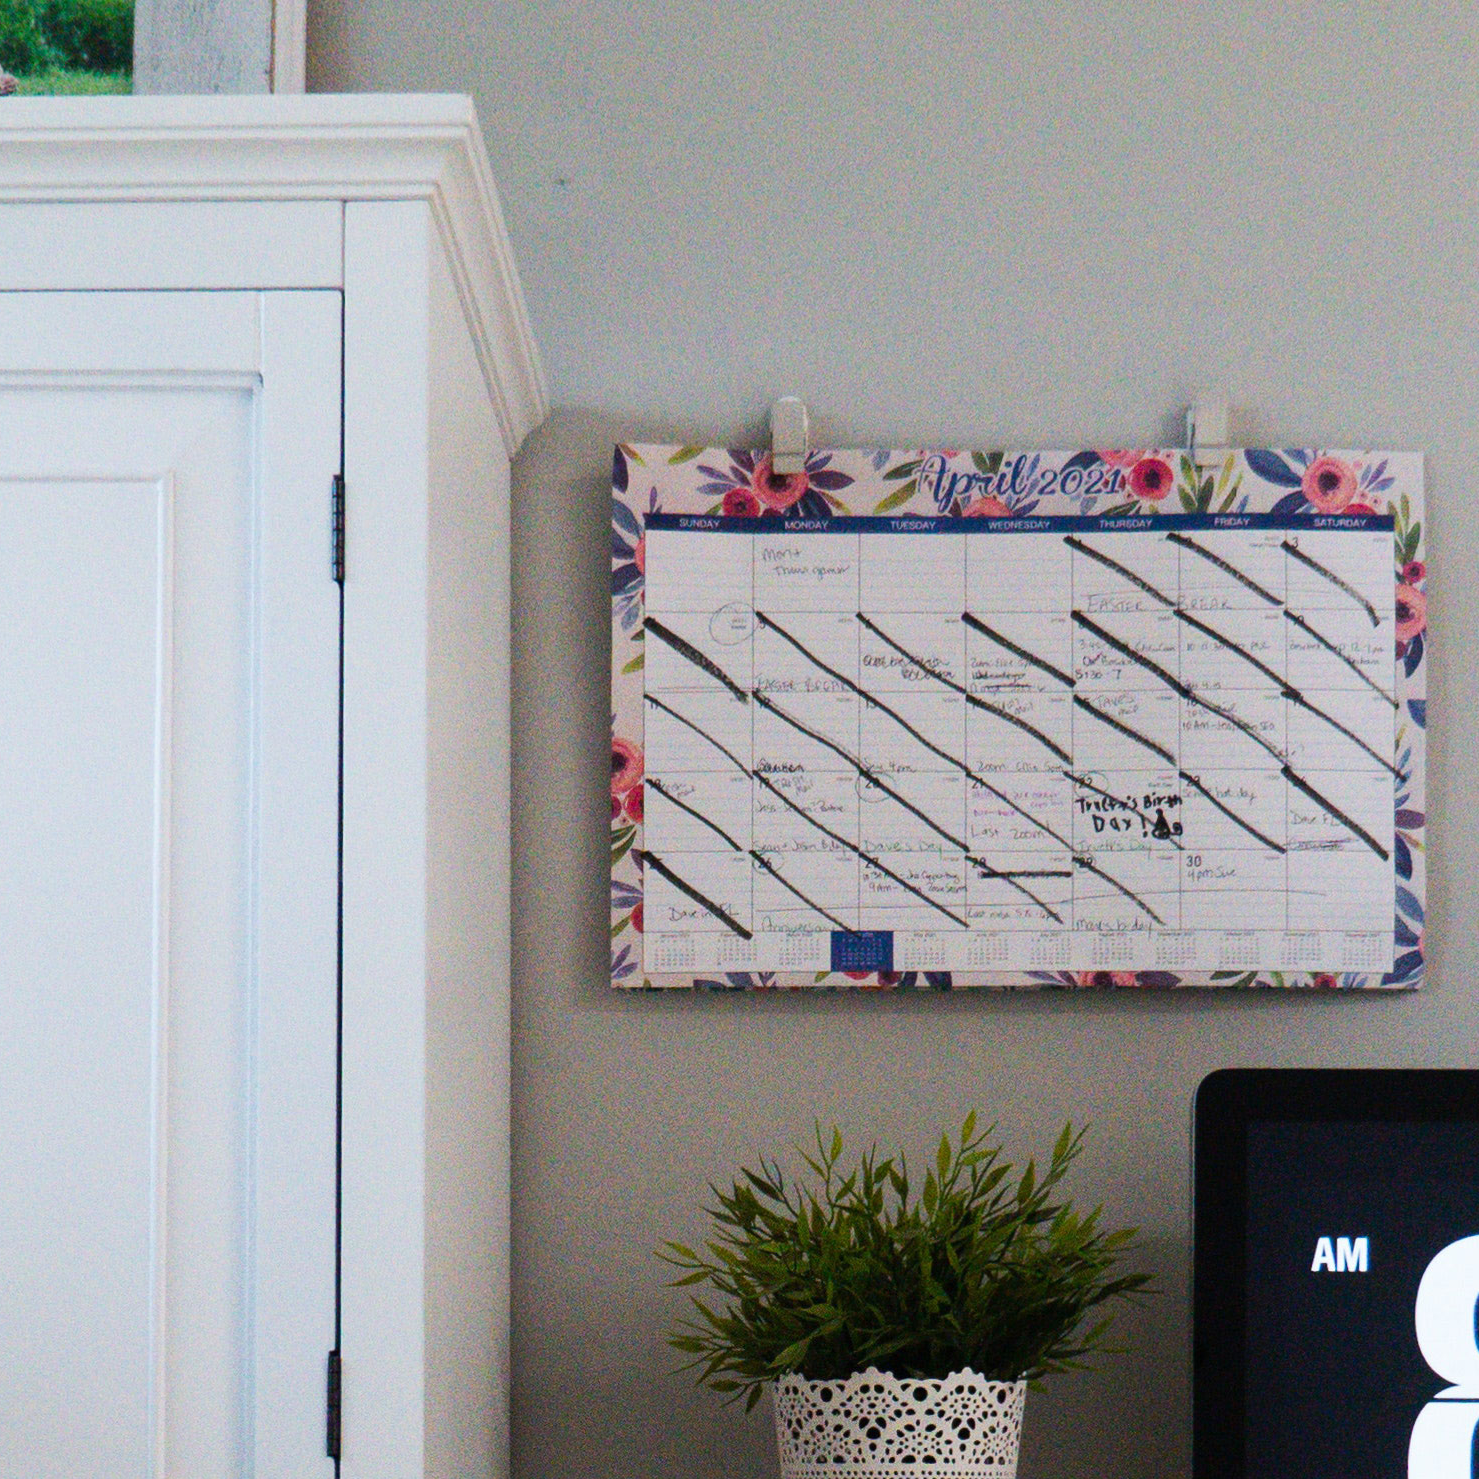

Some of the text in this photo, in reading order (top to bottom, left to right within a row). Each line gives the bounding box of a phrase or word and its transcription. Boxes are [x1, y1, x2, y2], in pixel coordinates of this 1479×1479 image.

[914, 453, 1123, 514] April 2021
[678, 517, 1368, 531] SUNDAY MONDAY TUESDAY WEDNESDAY THURSDAY FRIDAY SATURDAY
[1185, 855, 1203, 867] 30
[1310, 1236, 1370, 1274] AM
